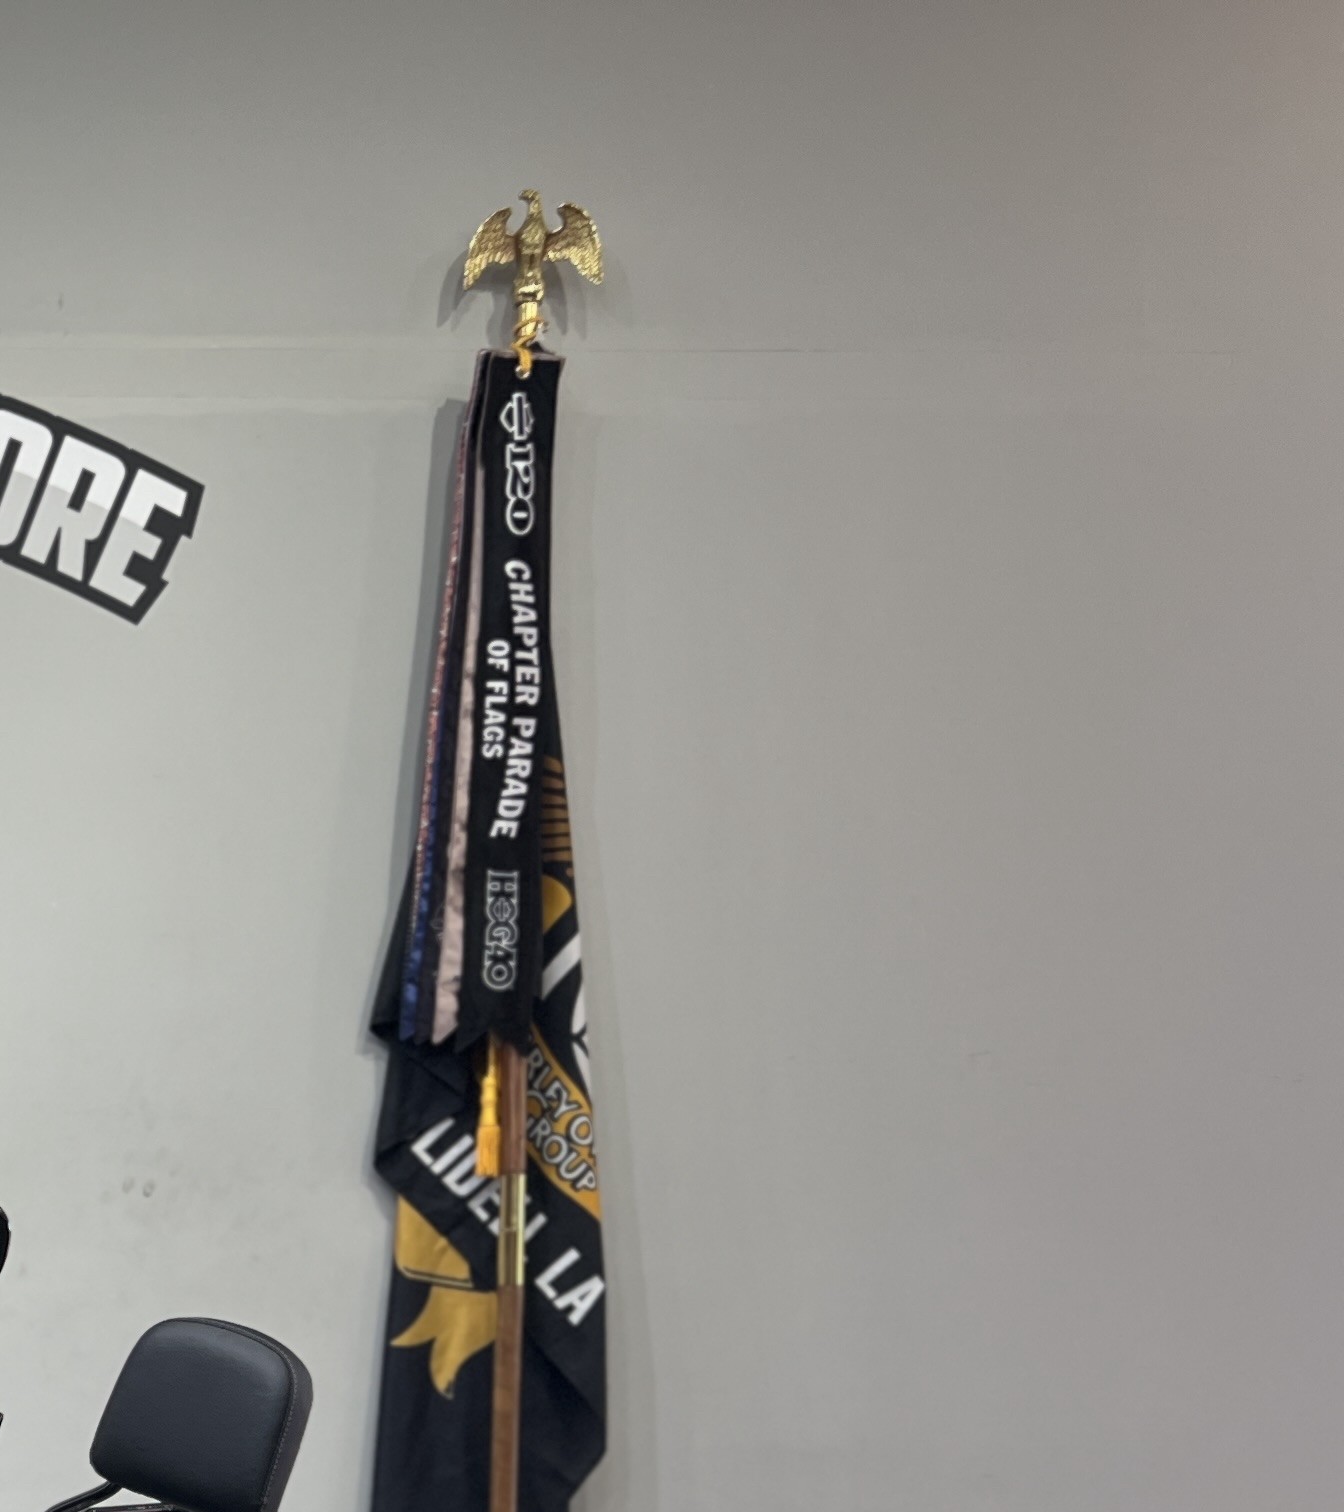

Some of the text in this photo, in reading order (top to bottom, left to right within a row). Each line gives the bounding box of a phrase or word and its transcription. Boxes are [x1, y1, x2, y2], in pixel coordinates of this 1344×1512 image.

[481, 639, 510, 760] OF FLAGS
[488, 559, 541, 839] CHAPTER PARADE
[533, 1246, 606, 1327] LA
